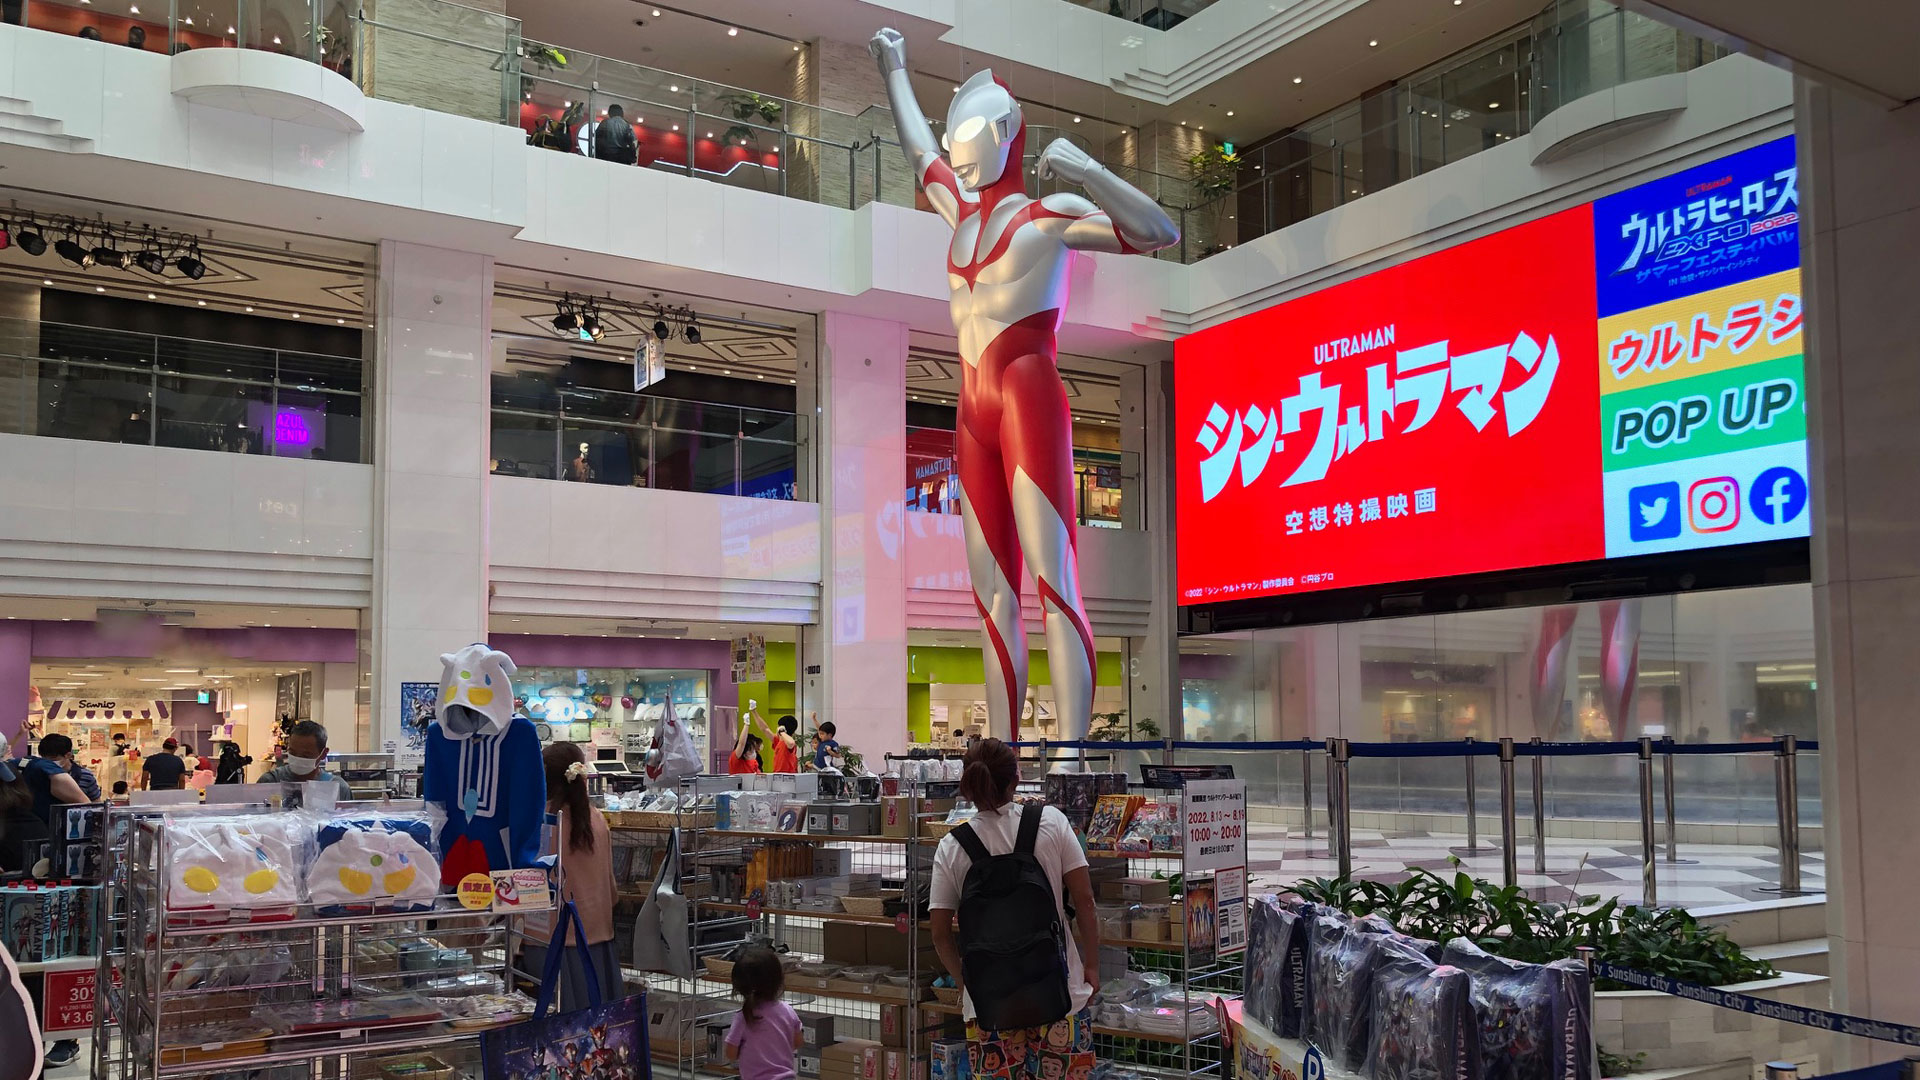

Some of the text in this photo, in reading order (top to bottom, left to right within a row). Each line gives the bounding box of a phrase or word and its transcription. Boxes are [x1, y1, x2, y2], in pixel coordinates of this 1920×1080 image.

[1686, 176, 1733, 198] ULTRAMAN
[1636, 230, 1795, 284] サマーフェスティバル
[1655, 211, 1800, 263] EXPO 2022
[1313, 323, 1396, 366] ULTRAMAN
[277, 413, 304, 429] AZUL
[1195, 330, 1561, 504] シン・ウルトラマン
[1615, 383, 1793, 451] POP UP
[1285, 487, 1437, 536] 空想特撮映画
[1190, 828, 1211, 843] 10:00
[1221, 824, 1242, 840] 20:00
[1290, 947, 1305, 1009] ULTRAMAN
[1607, 965, 1648, 986] Sunshine
[1650, 975, 1670, 993] City
[1677, 982, 1722, 1005] Sunshine
[1724, 992, 1747, 1011] City
[1754, 999, 1804, 1023] Sunshine
[1808, 1011, 1834, 1030] City
[1842, 1018, 1899, 1042] Sunshine
